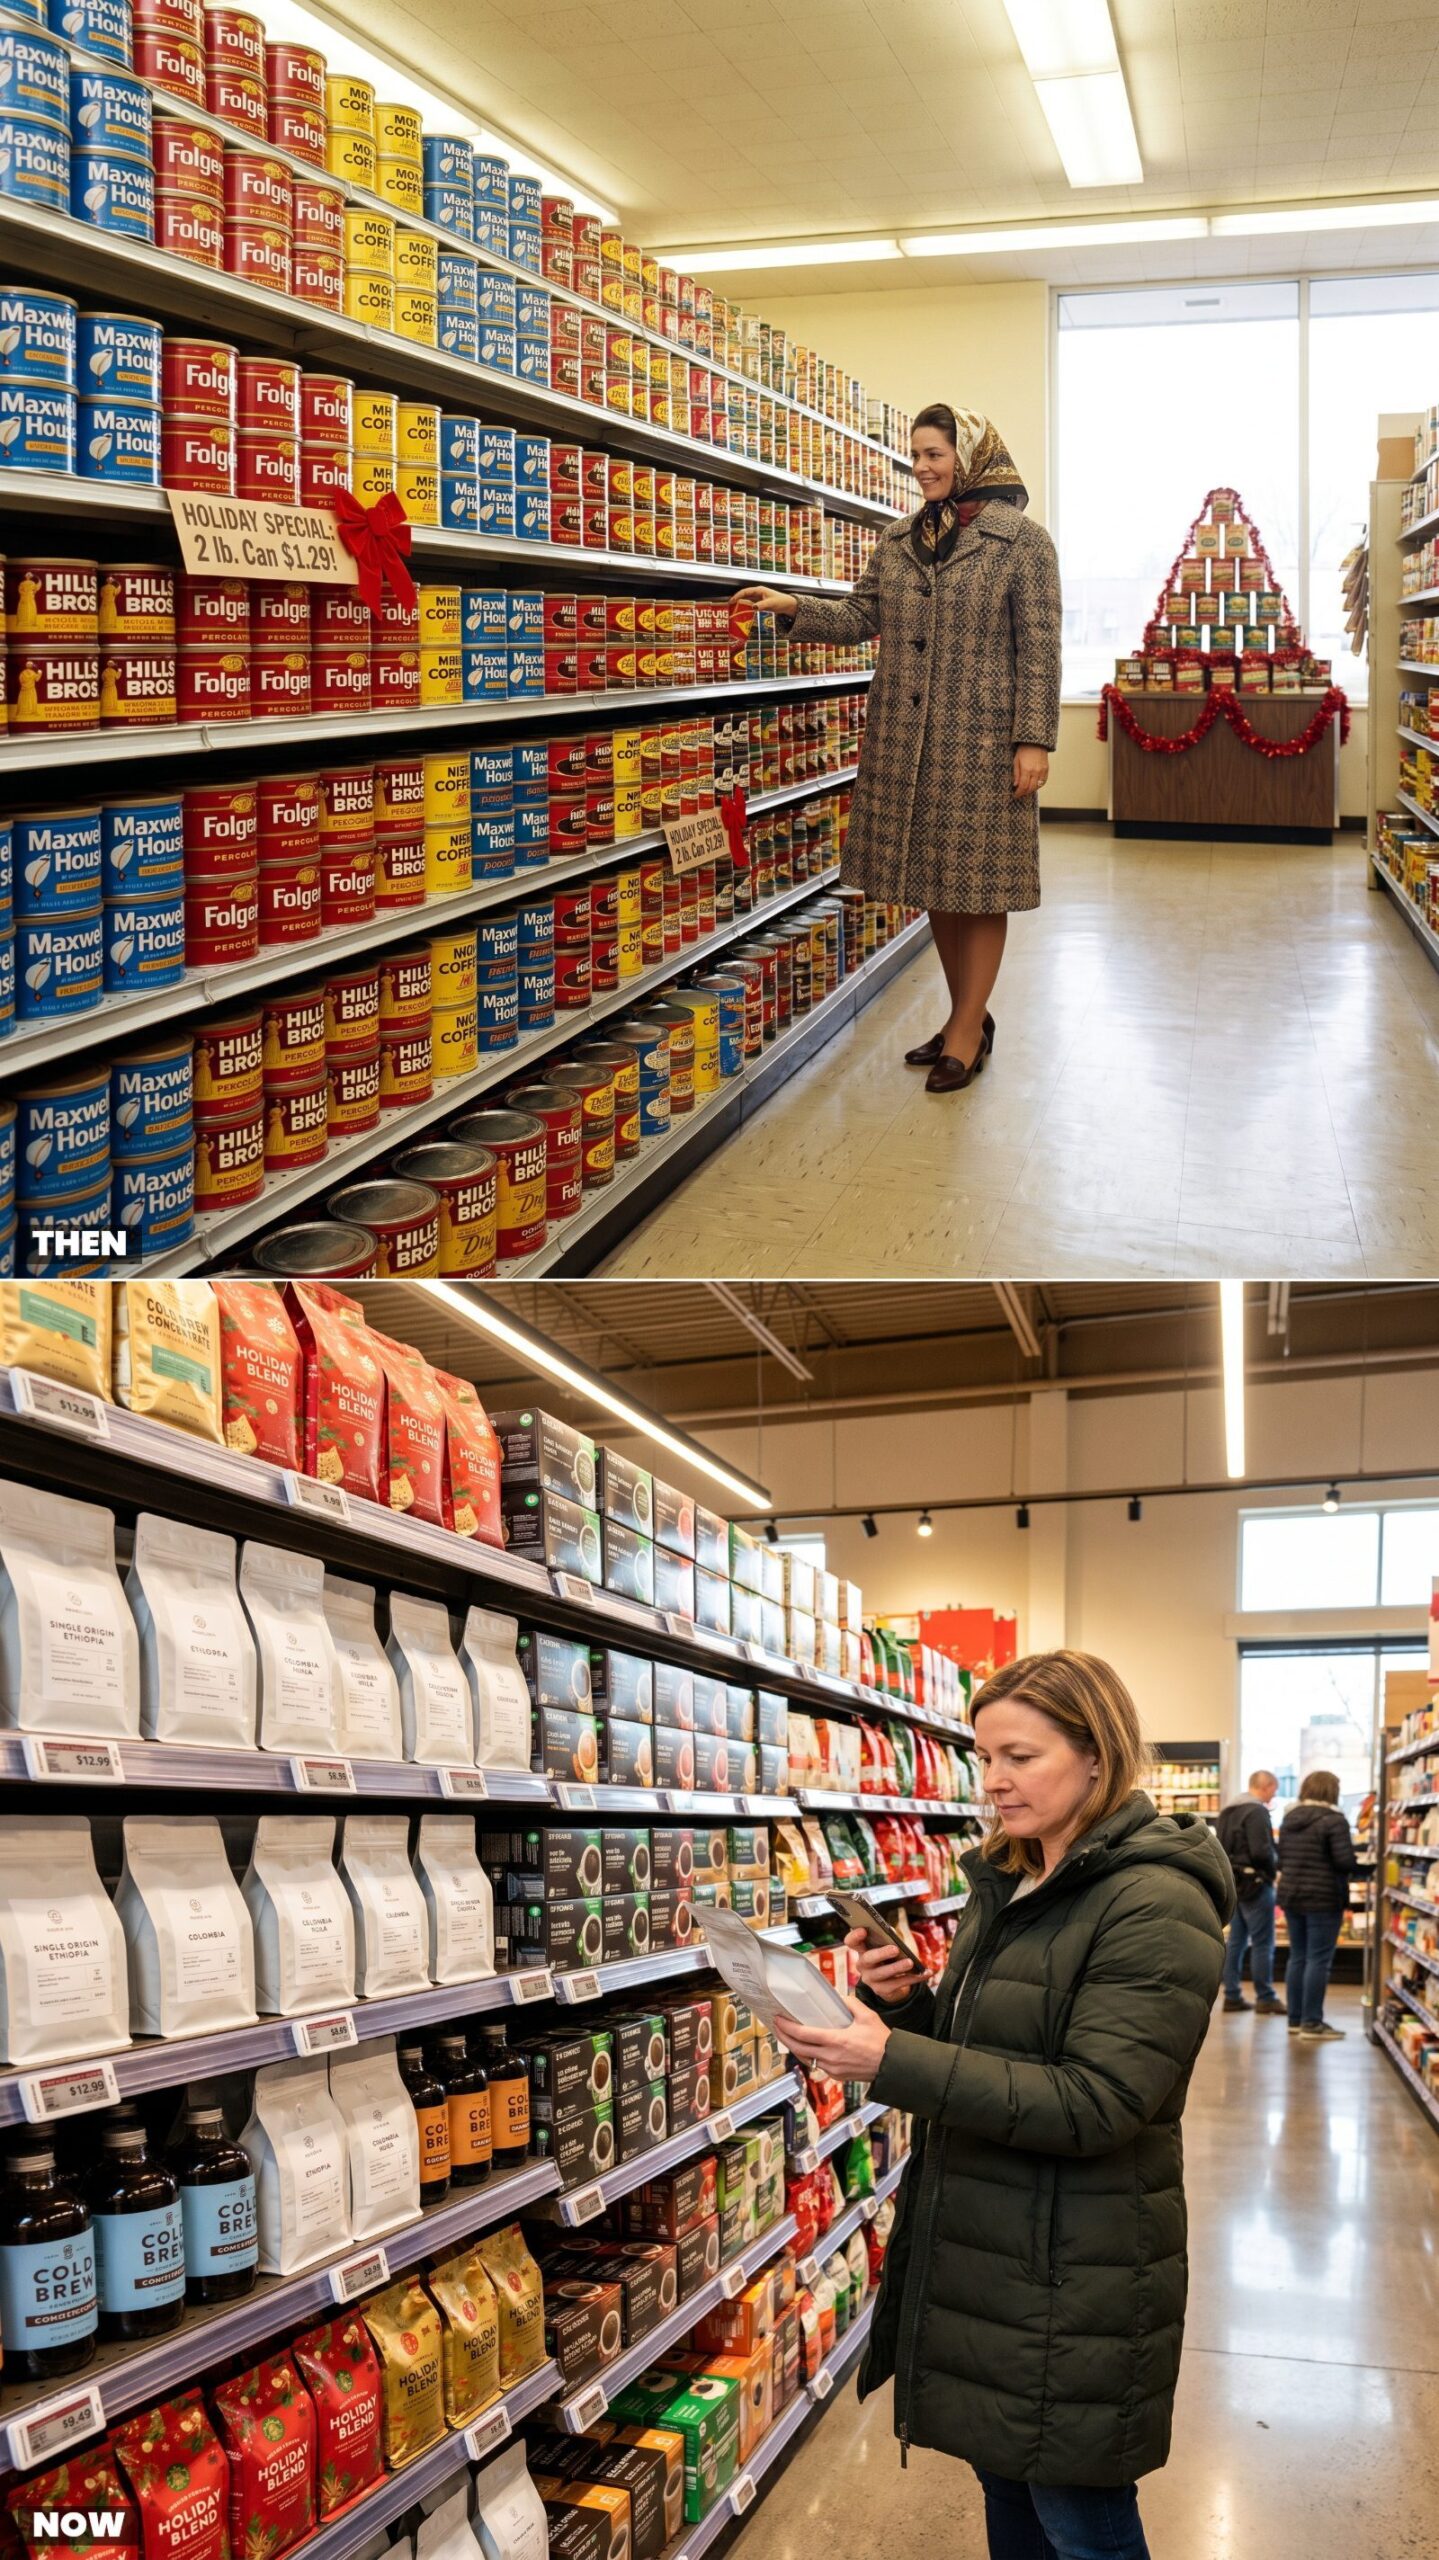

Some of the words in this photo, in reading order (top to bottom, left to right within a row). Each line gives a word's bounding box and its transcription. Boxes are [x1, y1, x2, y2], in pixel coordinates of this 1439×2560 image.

[182, 502, 257, 533] HOLIDAY
[264, 512, 336, 540] SPECIAL:
[194, 535, 209, 562] 2
[214, 537, 238, 565] lb.
[243, 543, 278, 568] Can
[283, 545, 338, 572] $1.29!
[45, 573, 98, 594] HILLS
[126, 578, 174, 597] HILLS
[46, 594, 97, 612] BROS
[126, 596, 174, 615] BROS
[46, 660, 99, 681] HILLS
[126, 660, 175, 678] HILLS
[47, 680, 100, 699] BROS
[127, 677, 176, 696] BROS
[333, 781, 374, 797] HILLS
[391, 771, 424, 787] HILLS
[333, 796, 374, 812] BROS
[392, 786, 424, 802] BROS
[391, 846, 425, 861] HILLS
[675, 848, 682, 864] 2
[682, 844, 692, 860] lb.
[392, 860, 425, 876] BROS
[399, 961, 432, 984] HILLS
[342, 981, 378, 1004] HILLS
[400, 979, 432, 998] BROS
[287, 1005, 324, 1028] HILLS
[342, 999, 378, 1019] BROS
[219, 1032, 262, 1058] HILLS
[287, 1024, 324, 1046] BROS
[400, 1036, 432, 1056] HILLS
[219, 1051, 262, 1076] BROS
[343, 1061, 379, 1083] HILLS
[400, 1054, 432, 1074] BROS
[290, 1088, 327, 1113] HILLS
[343, 1081, 379, 1101] BROS
[291, 1108, 327, 1131] BROS
[219, 1122, 263, 1150] HILLS
[219, 1142, 263, 1168] BROS
[458, 1178, 496, 1203] HILLS
[458, 1197, 496, 1221] BROS
[236, 1344, 293, 1376] HOLIDAY
[247, 1363, 289, 1388] BLEND
[331, 1382, 377, 1410] HOLIDAY
[60, 1399, 96, 1419] $12.99
[338, 1398, 375, 1421] BLEND
[401, 1414, 440, 1438] HOLIDAY
[407, 1430, 440, 1449] BLEND
[459, 1447, 497, 1469] HOLIDAY
[467, 1462, 496, 1479] BLEND
[50, 1620, 82, 1634] SINGLE
[84, 1626, 114, 1637] ORIGIN
[63, 1633, 104, 1646] ETHIOPIA
[76, 1755, 110, 1766] $12.99
[34, 1943, 66, 1953] SINGLE
[66, 1940, 99, 1949] ORIGIN
[188, 1931, 225, 1941] COLOMBIA
[49, 1950, 89, 1961] ETHIOPIA
[69, 2081, 104, 2096] $12.99
[33, 2255, 92, 2284] COLD
[36, 2274, 94, 2302] BREW
[509, 2296, 542, 2319] HOLIDAY
[516, 2308, 541, 2327] BLEND
[463, 2325, 497, 2351] HOLIDAY
[470, 2338, 496, 2361] BLEND
[399, 2358, 440, 2389] HOLIDAY
[407, 2375, 438, 2397] BLEND
[62, 2409, 91, 2429] $9.49
[330, 2394, 378, 2431] HOLIDAY
[338, 2411, 376, 2440] BLEND
[258, 2440, 309, 2482] HOLIDAY
[267, 2461, 305, 2492] BLEND
[158, 2488, 222, 2536] HOLIDAY
[170, 2509, 218, 2546] BLEND
